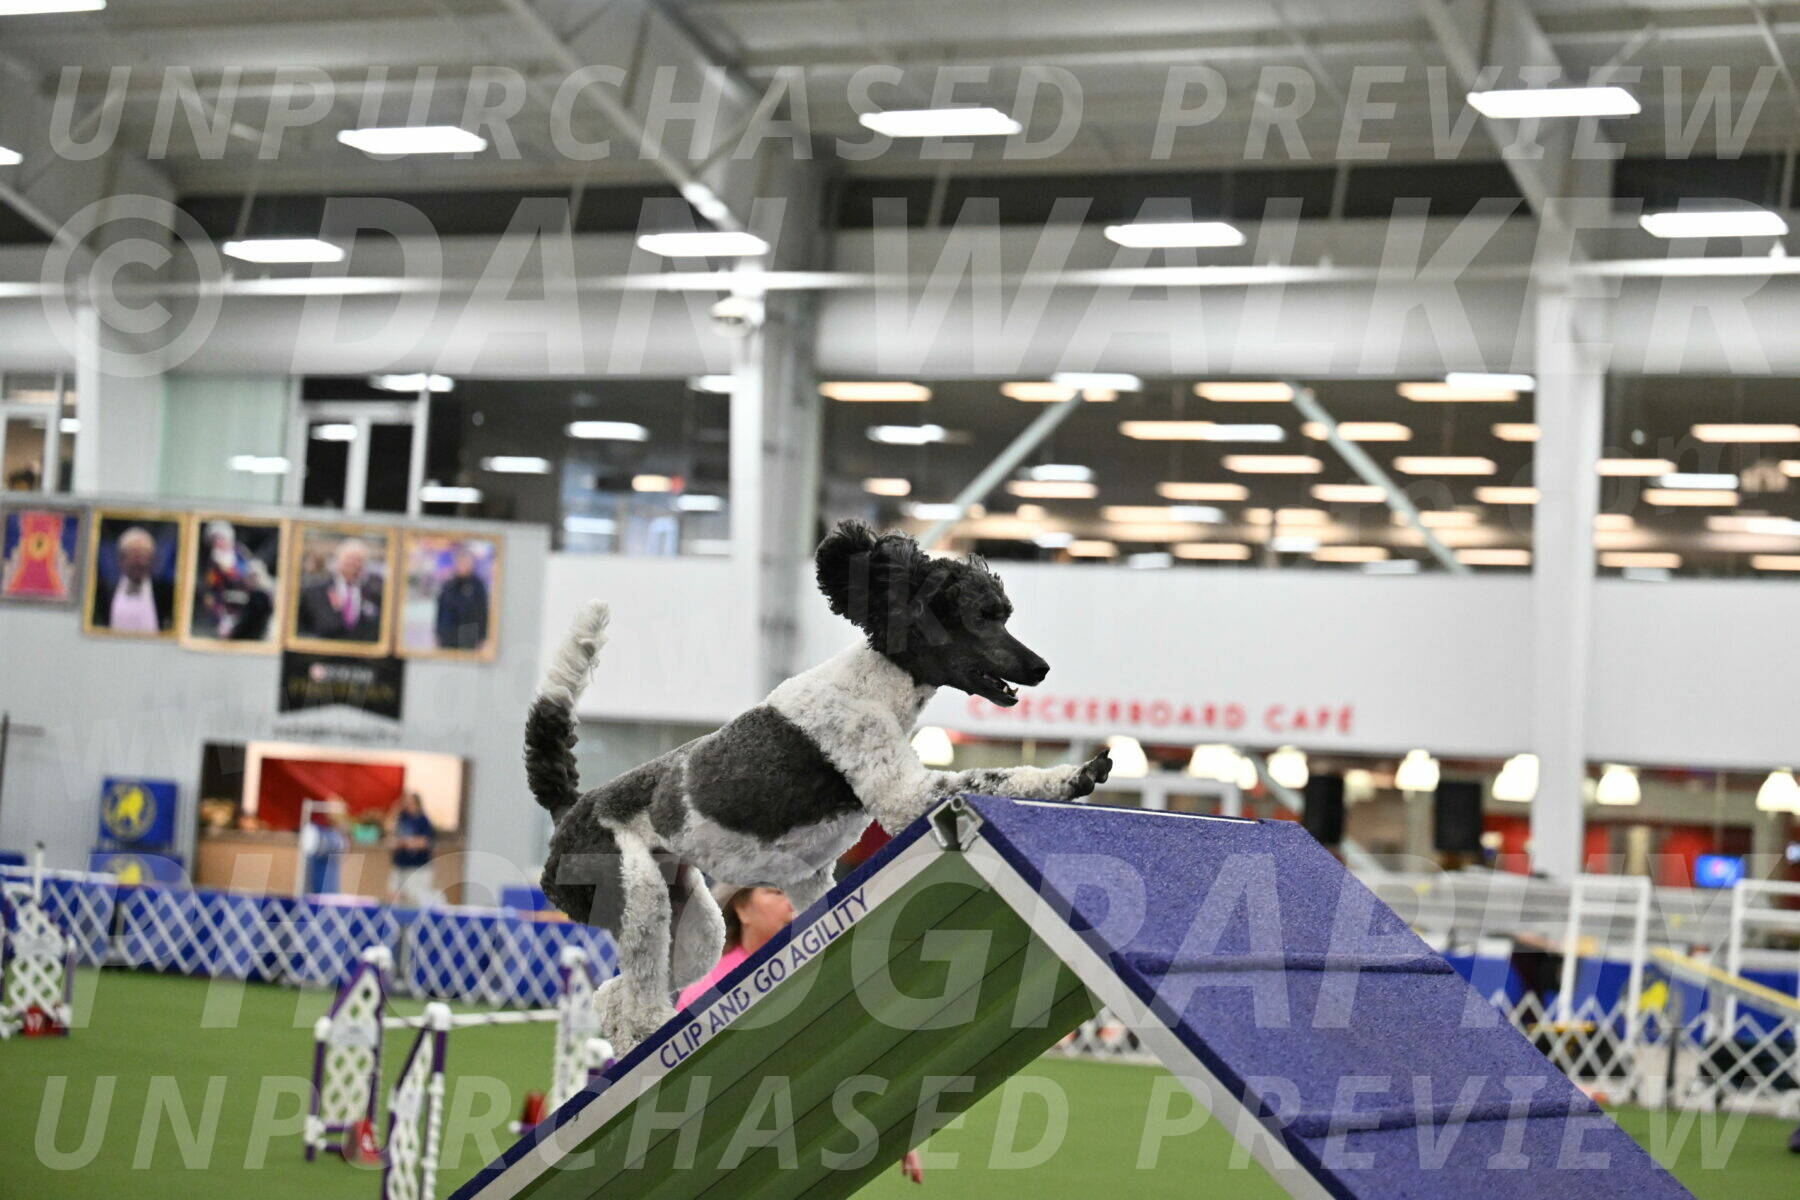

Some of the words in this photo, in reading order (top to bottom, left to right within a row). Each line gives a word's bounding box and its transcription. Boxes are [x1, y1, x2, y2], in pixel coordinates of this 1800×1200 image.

[1264, 702, 1355, 735] CAFÉ
[660, 1022, 702, 1068] CLIP
[709, 987, 750, 1034] AND
[754, 957, 787, 994] GO
[790, 887, 870, 969] AGILITY
